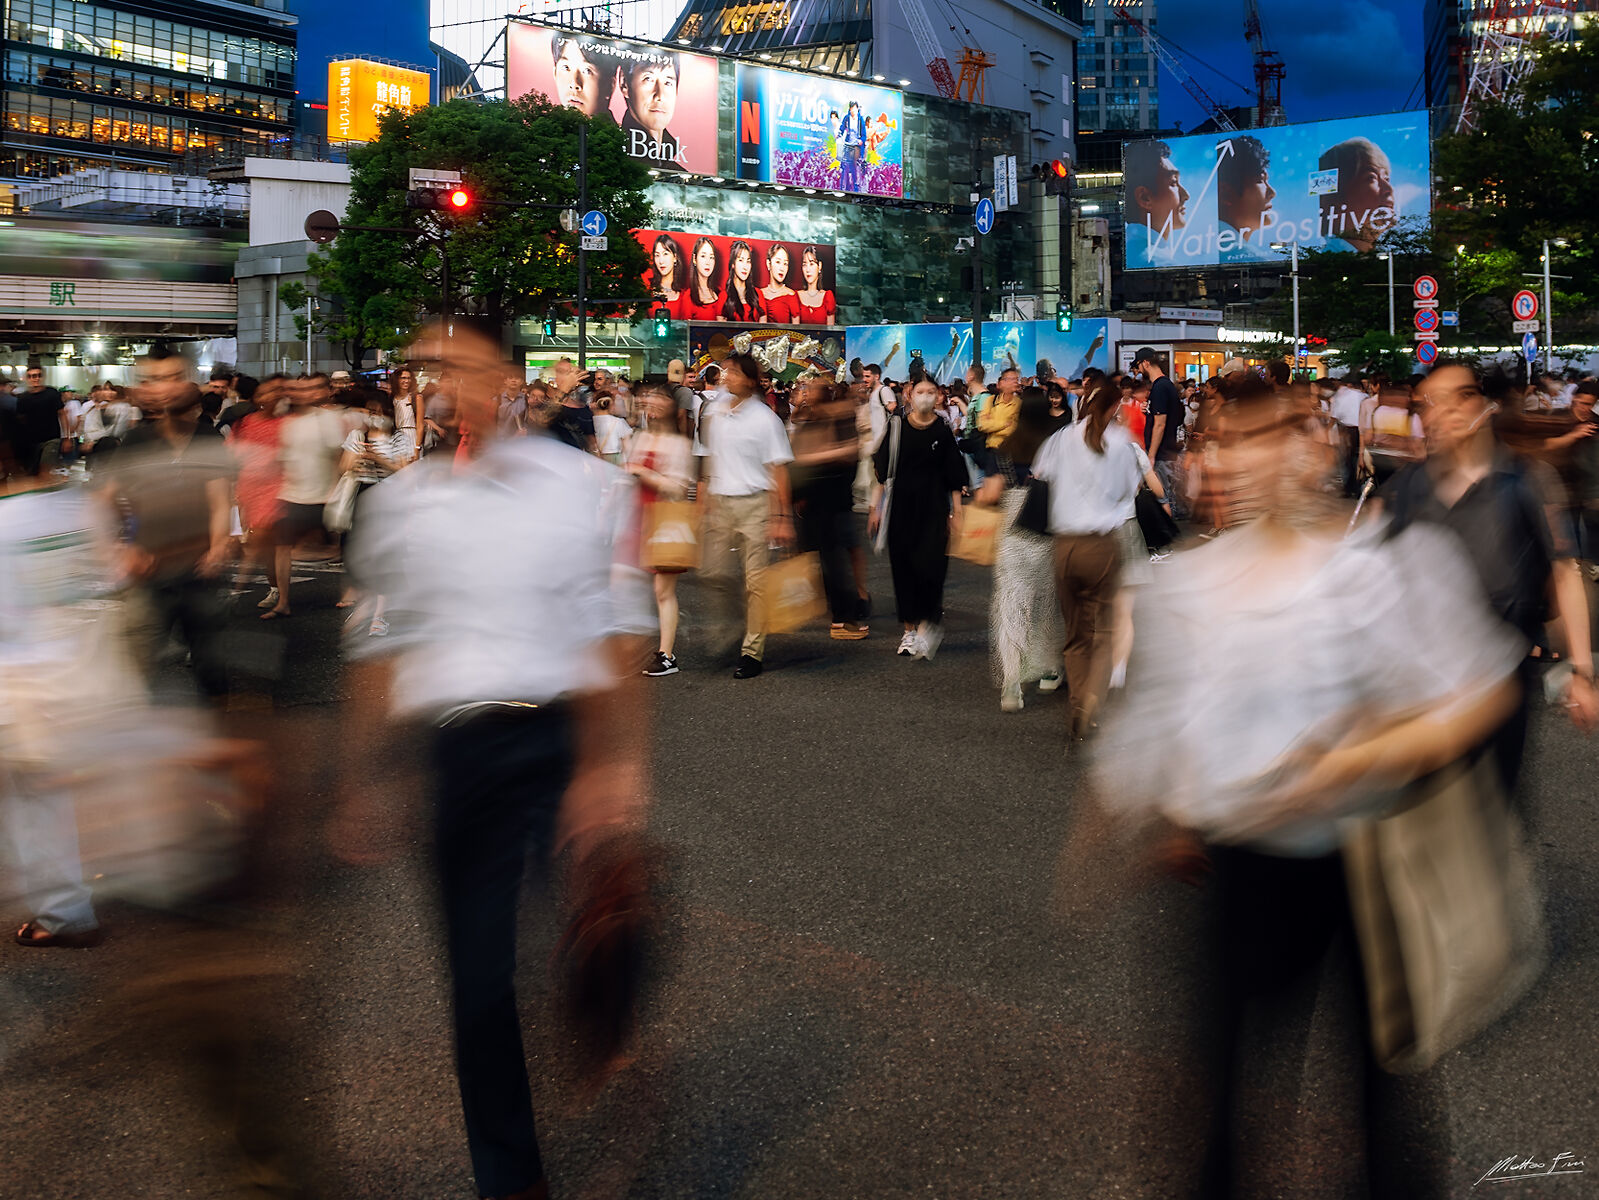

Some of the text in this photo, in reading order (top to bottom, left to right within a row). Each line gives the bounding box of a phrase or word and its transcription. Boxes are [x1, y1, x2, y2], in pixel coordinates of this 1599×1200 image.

[624, 128, 689, 163] Bank
[1145, 202, 1398, 264] Water Positive
[49, 282, 76, 306] 駅
